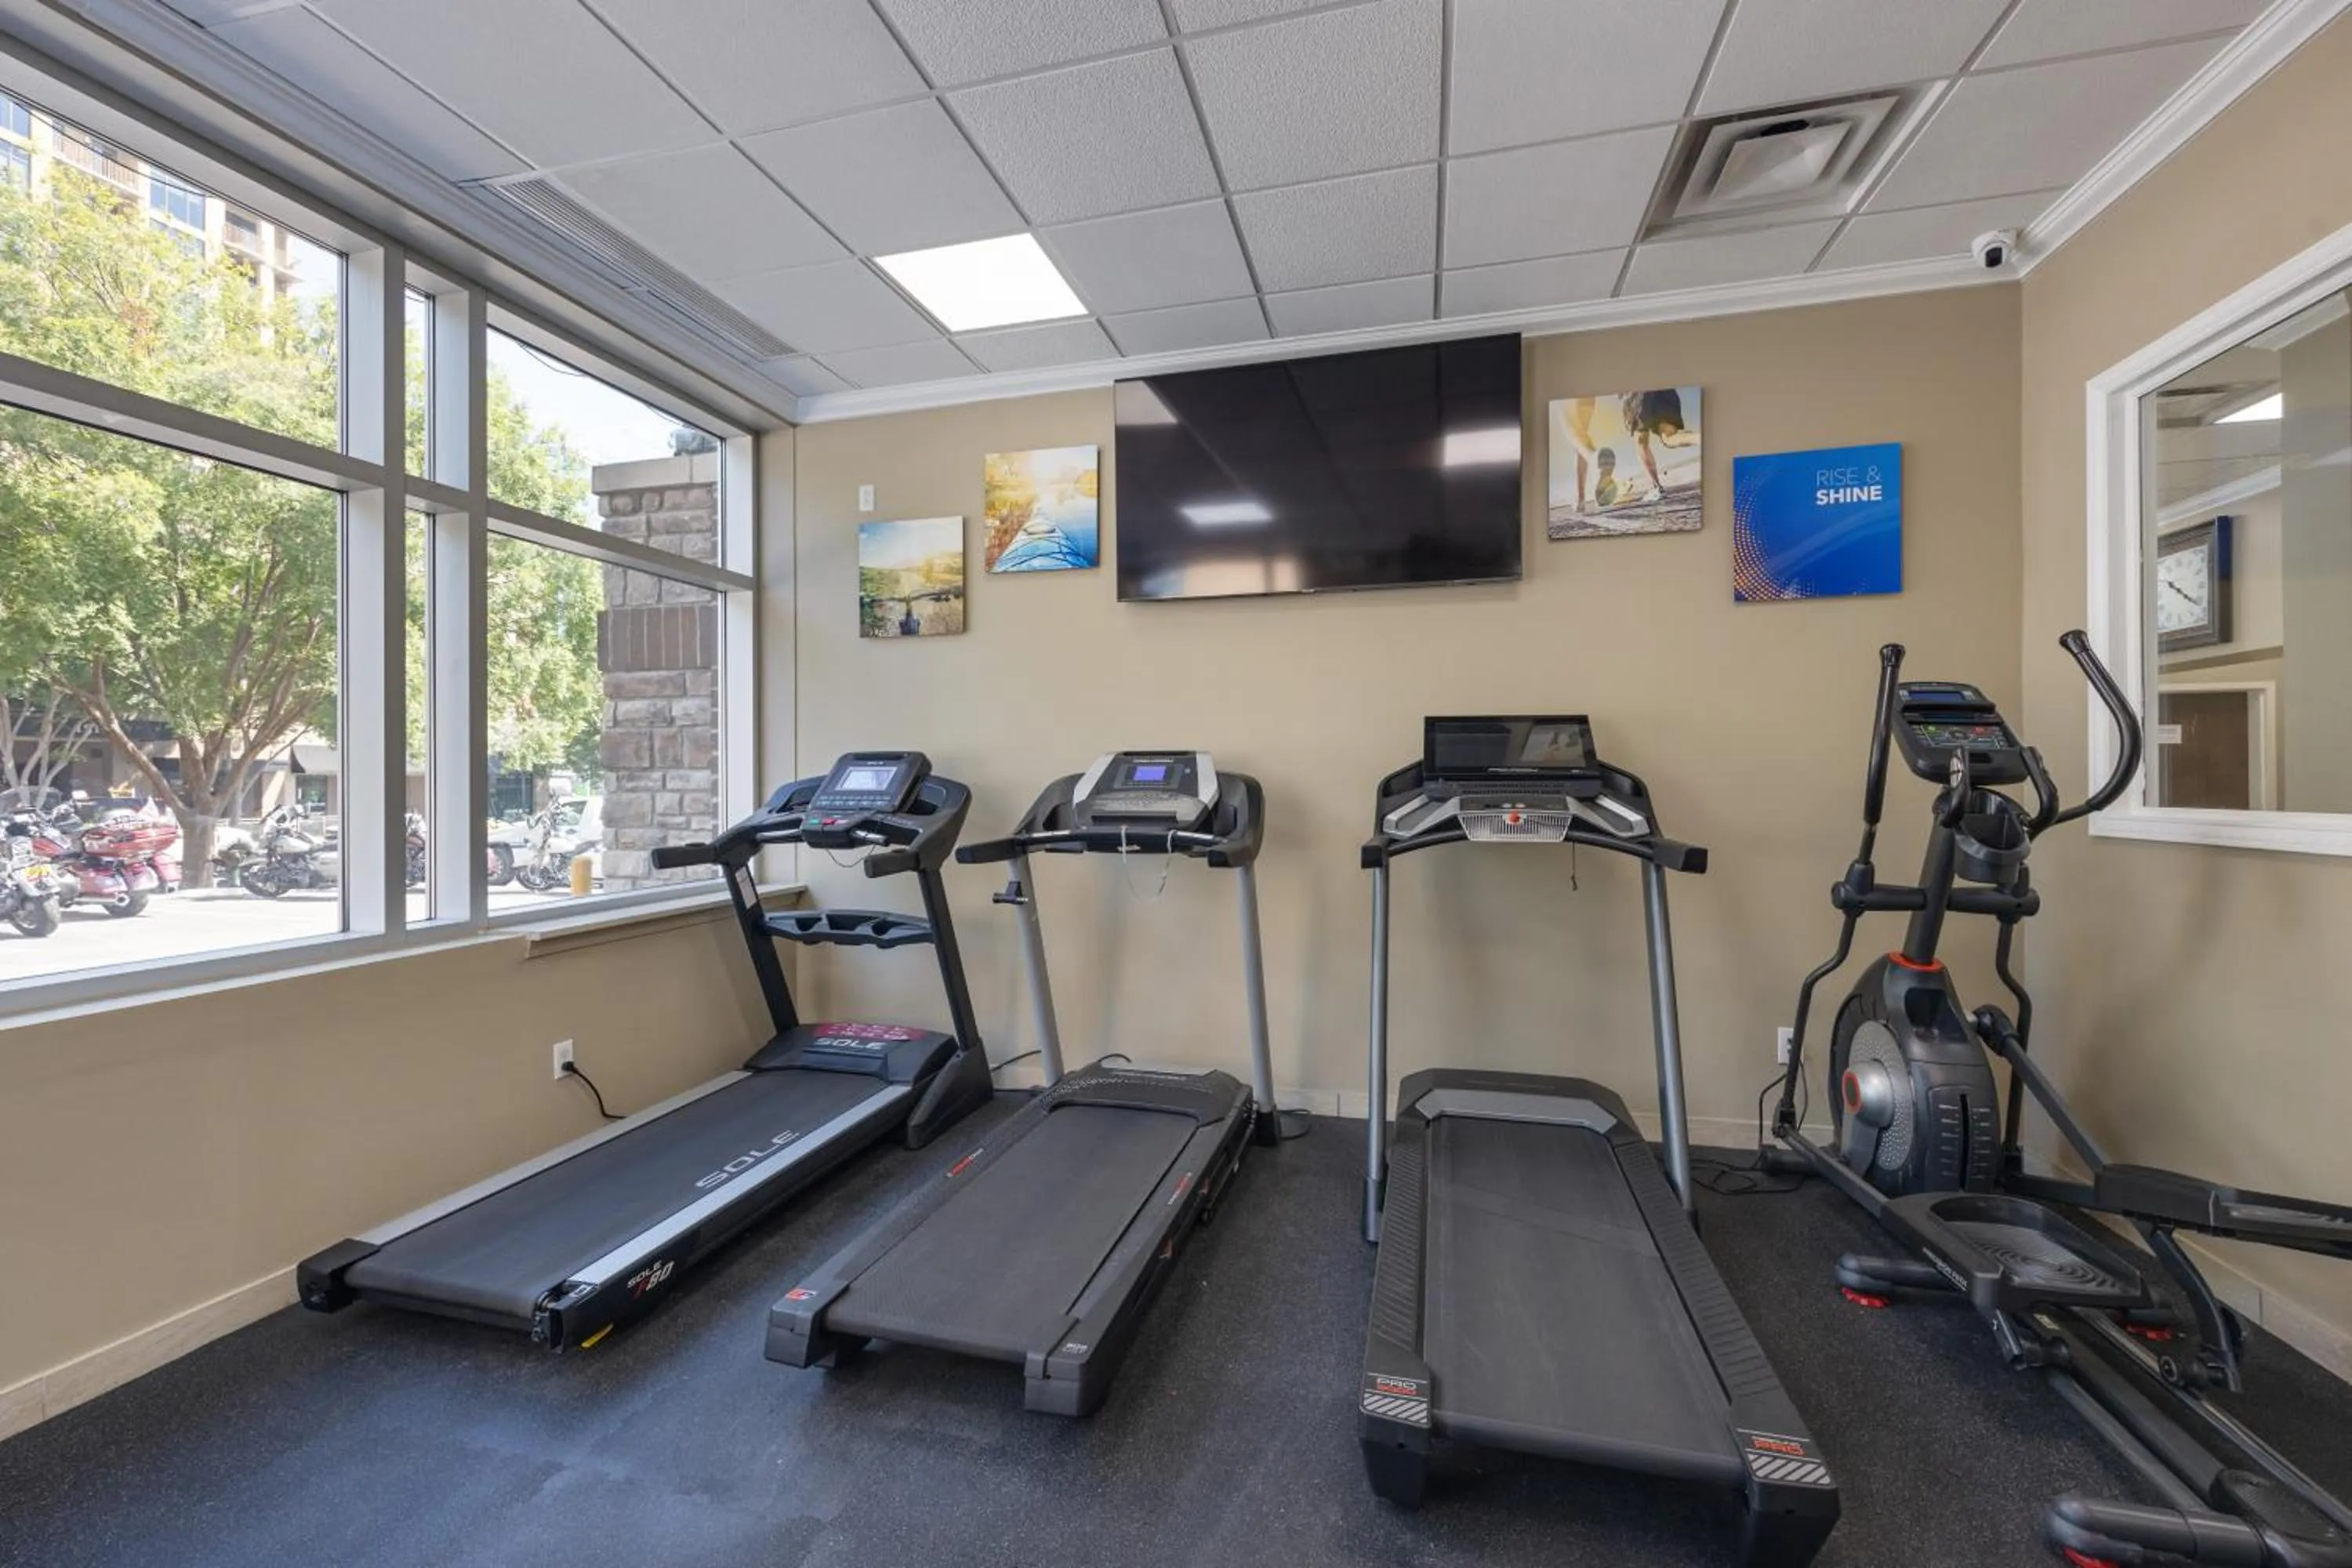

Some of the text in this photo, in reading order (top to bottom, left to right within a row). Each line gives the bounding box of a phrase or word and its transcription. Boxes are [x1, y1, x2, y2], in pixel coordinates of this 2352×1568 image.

[1817, 465, 1882, 485] RISE &
[1816, 485, 1882, 506] SHINE
[815, 1037, 887, 1050] SOLE
[695, 1130, 800, 1189] SOLE
[627, 1260, 662, 1288] SOLE
[1377, 1377, 1417, 1390] PRO
